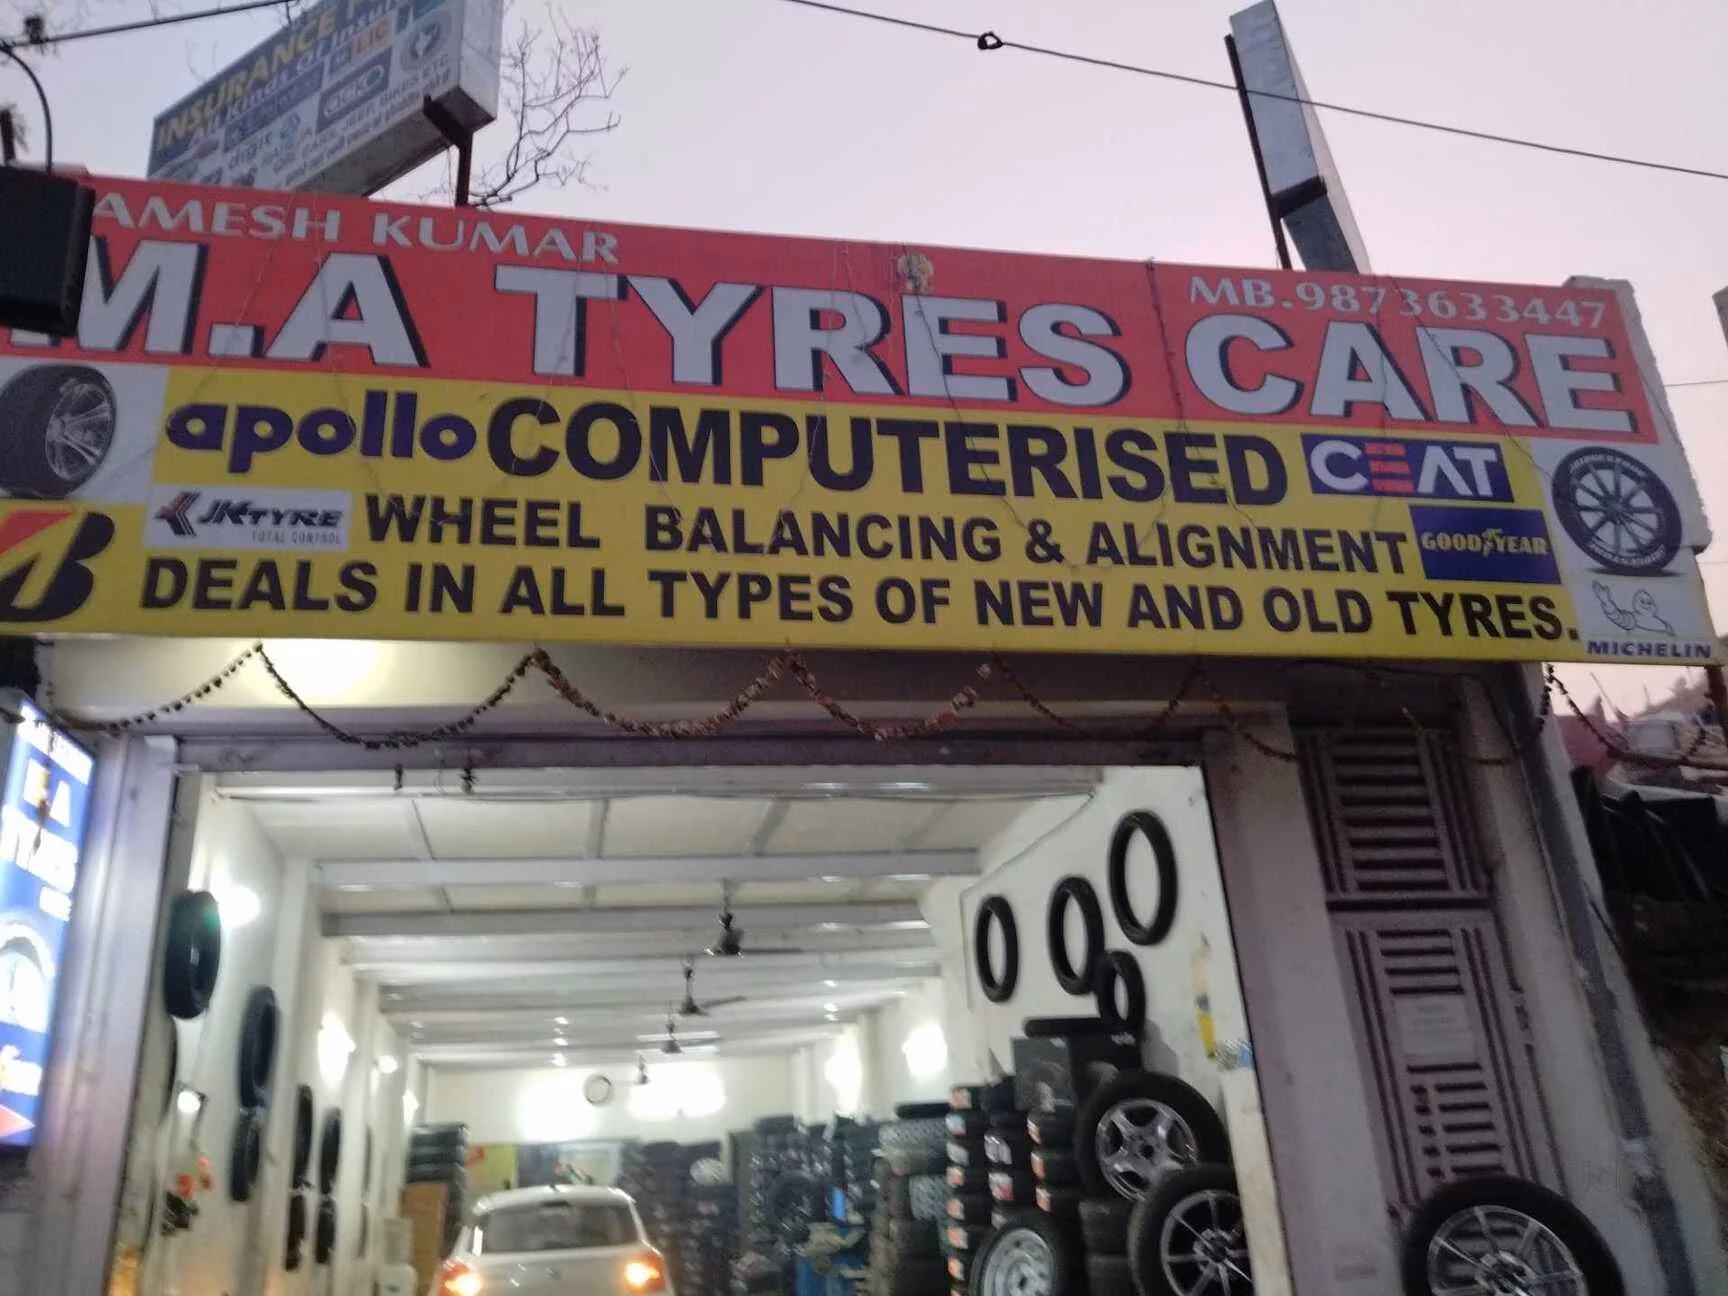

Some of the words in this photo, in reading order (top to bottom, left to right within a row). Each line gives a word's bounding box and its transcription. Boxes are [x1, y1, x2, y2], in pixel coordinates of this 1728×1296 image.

[158, 8, 337, 148] INSURANCE
[373, 212, 620, 264] KUMAR
[494, 264, 1131, 407] TYRES
[1184, 312, 1637, 432] CARE
[165, 389, 477, 474] apollo
[487, 397, 1289, 505] COMPUTERISED
[1310, 439, 1501, 497] CEAT
[365, 493, 601, 549] WHEEL
[645, 504, 1002, 562] BALANCING
[1025, 518, 1064, 565] &
[1086, 520, 1407, 574] ALIGNMENT
[139, 557, 378, 612] DEALS
[404, 562, 476, 613] IN
[500, 567, 625, 617] ALL
[648, 570, 854, 624] TYPES
[874, 577, 952, 626] OF
[975, 580, 1104, 629] NEW
[1127, 584, 1245, 632] AND
[1262, 586, 1373, 634] OLD
[1385, 590, 1579, 640] TYRES.
[1587, 639, 1712, 660] MICHELIN
